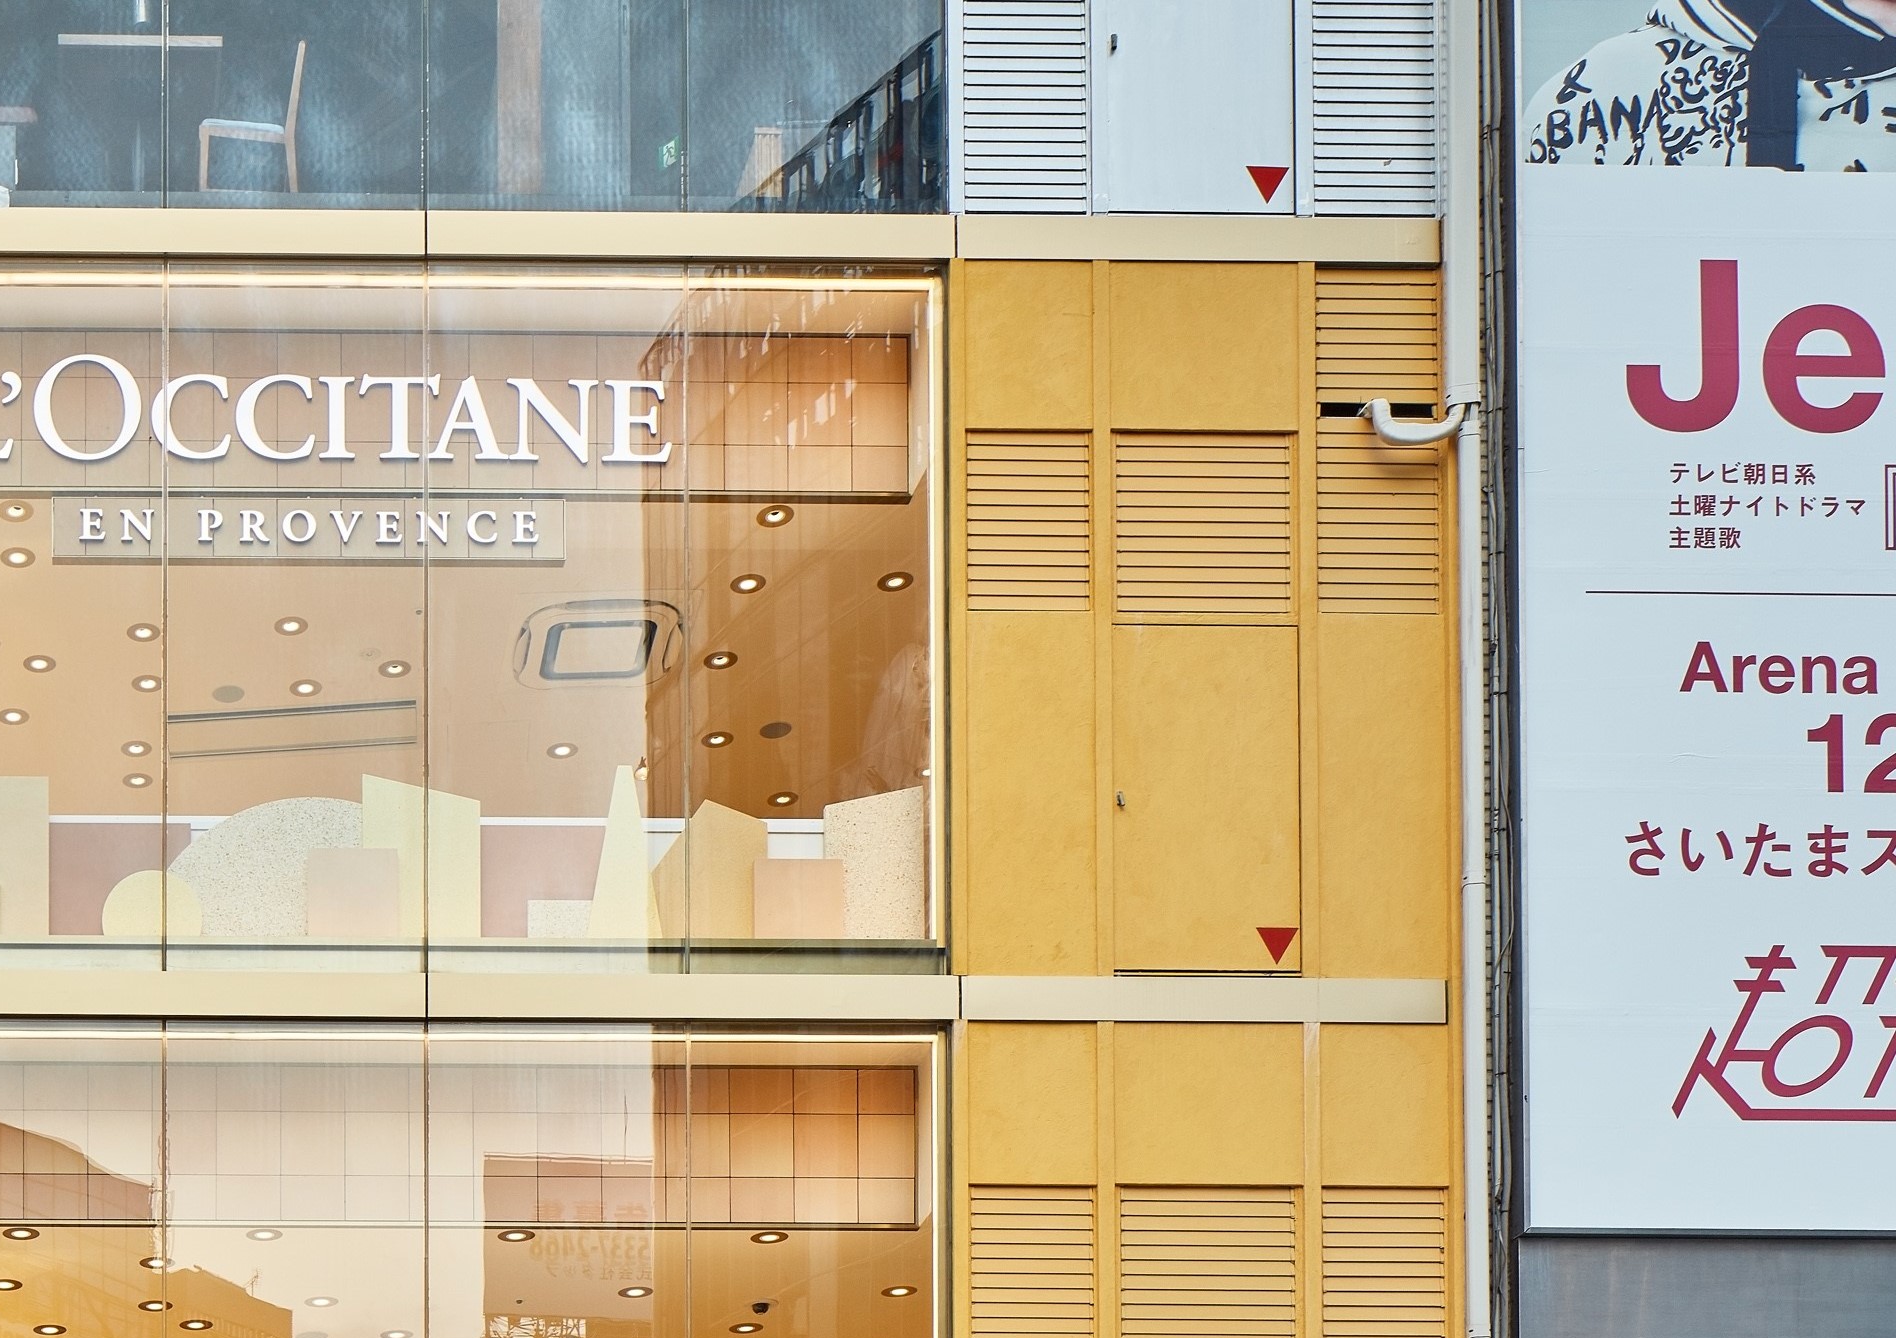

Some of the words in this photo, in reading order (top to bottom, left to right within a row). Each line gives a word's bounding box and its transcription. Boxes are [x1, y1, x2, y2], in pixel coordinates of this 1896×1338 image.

[1626, 259, 1886, 434] Je
[1669, 462, 1816, 486] テレビ朝日系
[77, 507, 156, 543] EN
[197, 507, 540, 546] PROVENCE
[1669, 494, 1867, 518] 土曜ナイトドラマ
[1669, 527, 1742, 550] 主題歌
[1679, 641, 1879, 694] Arena
[1807, 713, 1896, 794] 12
[1625, 820, 1896, 878] さいたまス
